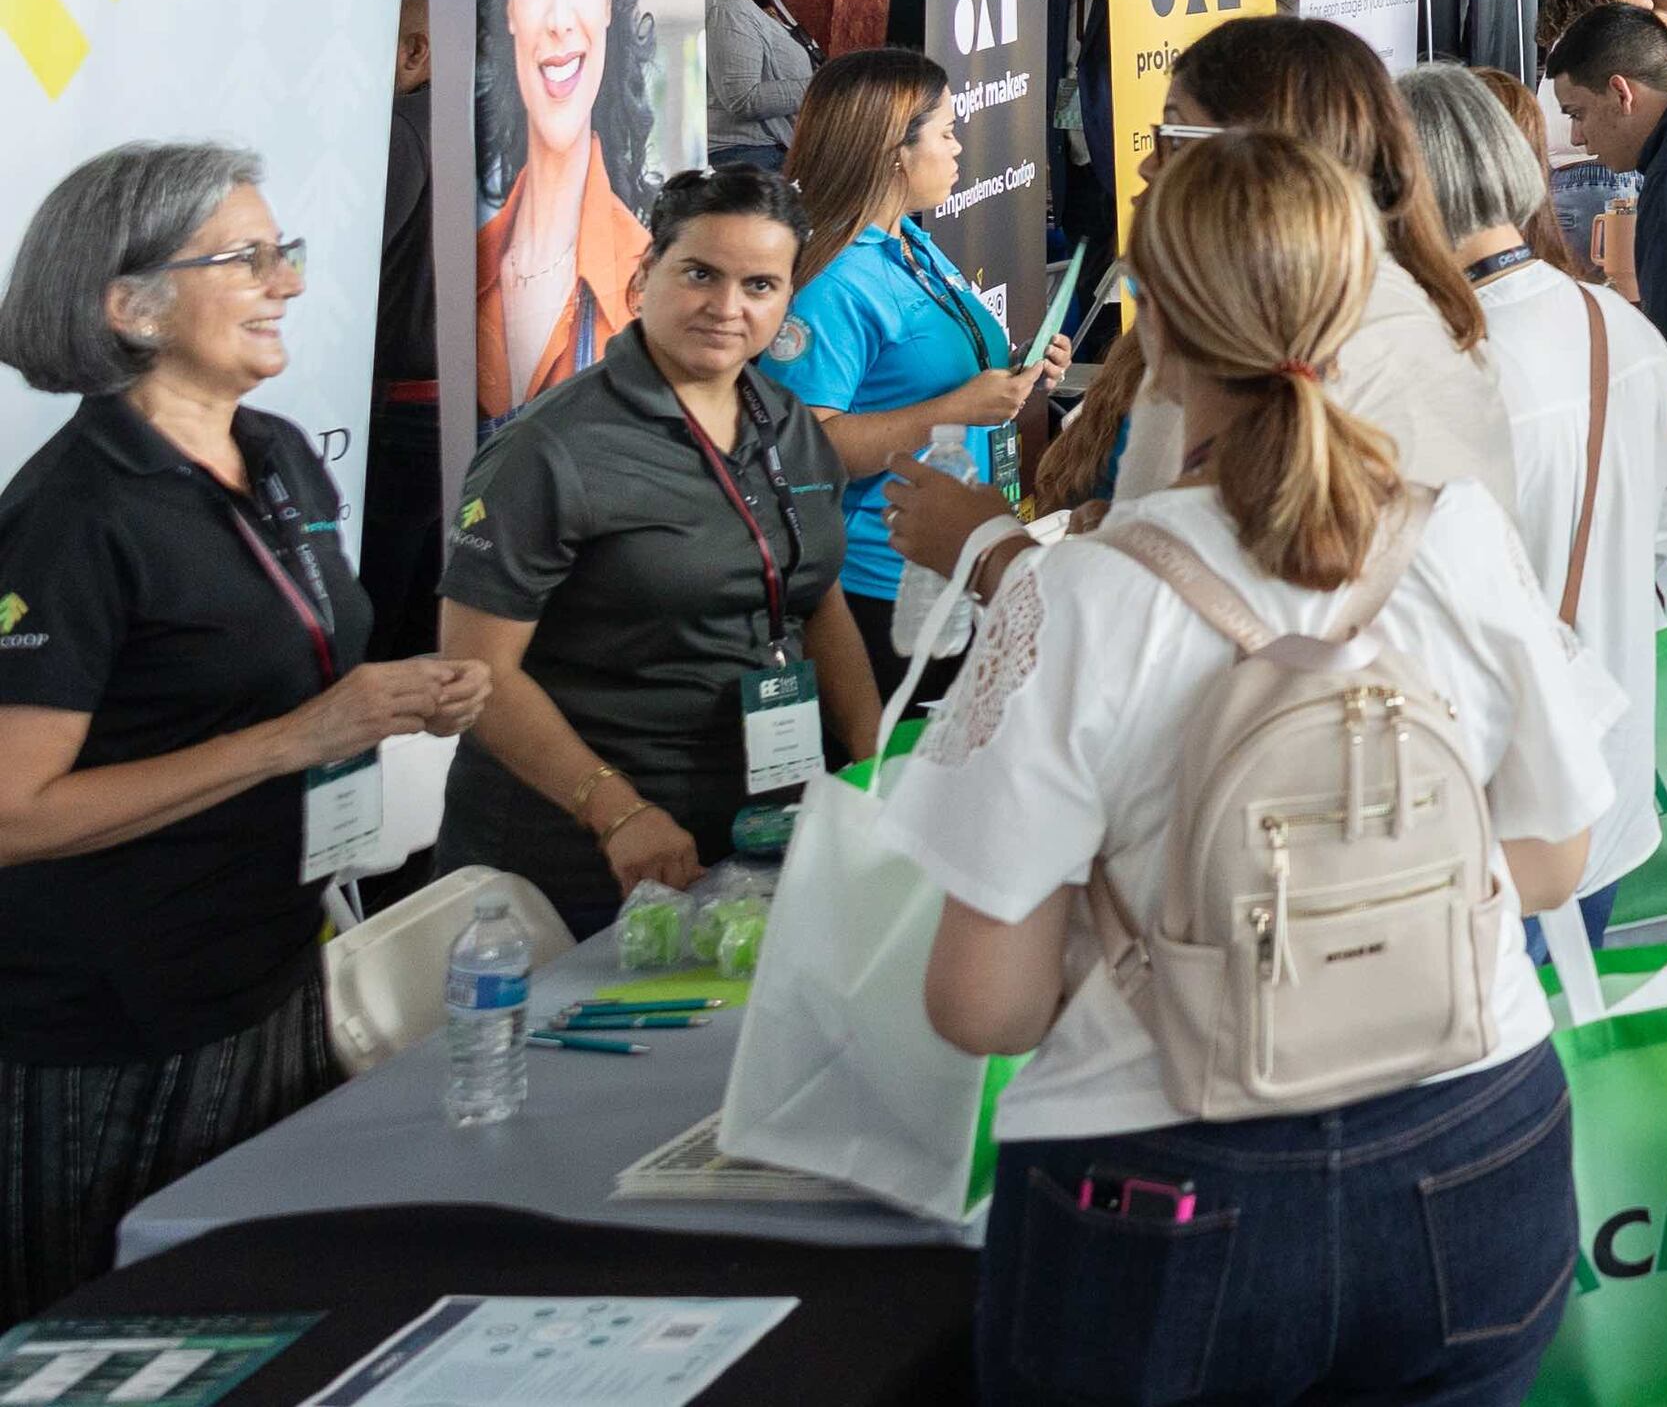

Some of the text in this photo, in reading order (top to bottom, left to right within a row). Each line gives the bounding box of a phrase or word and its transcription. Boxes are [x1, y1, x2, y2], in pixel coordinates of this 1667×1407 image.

[1340, 0, 1362, 18] stage
[951, 71, 1029, 123] roject makers
[1005, 160, 1036, 191] Contigo
